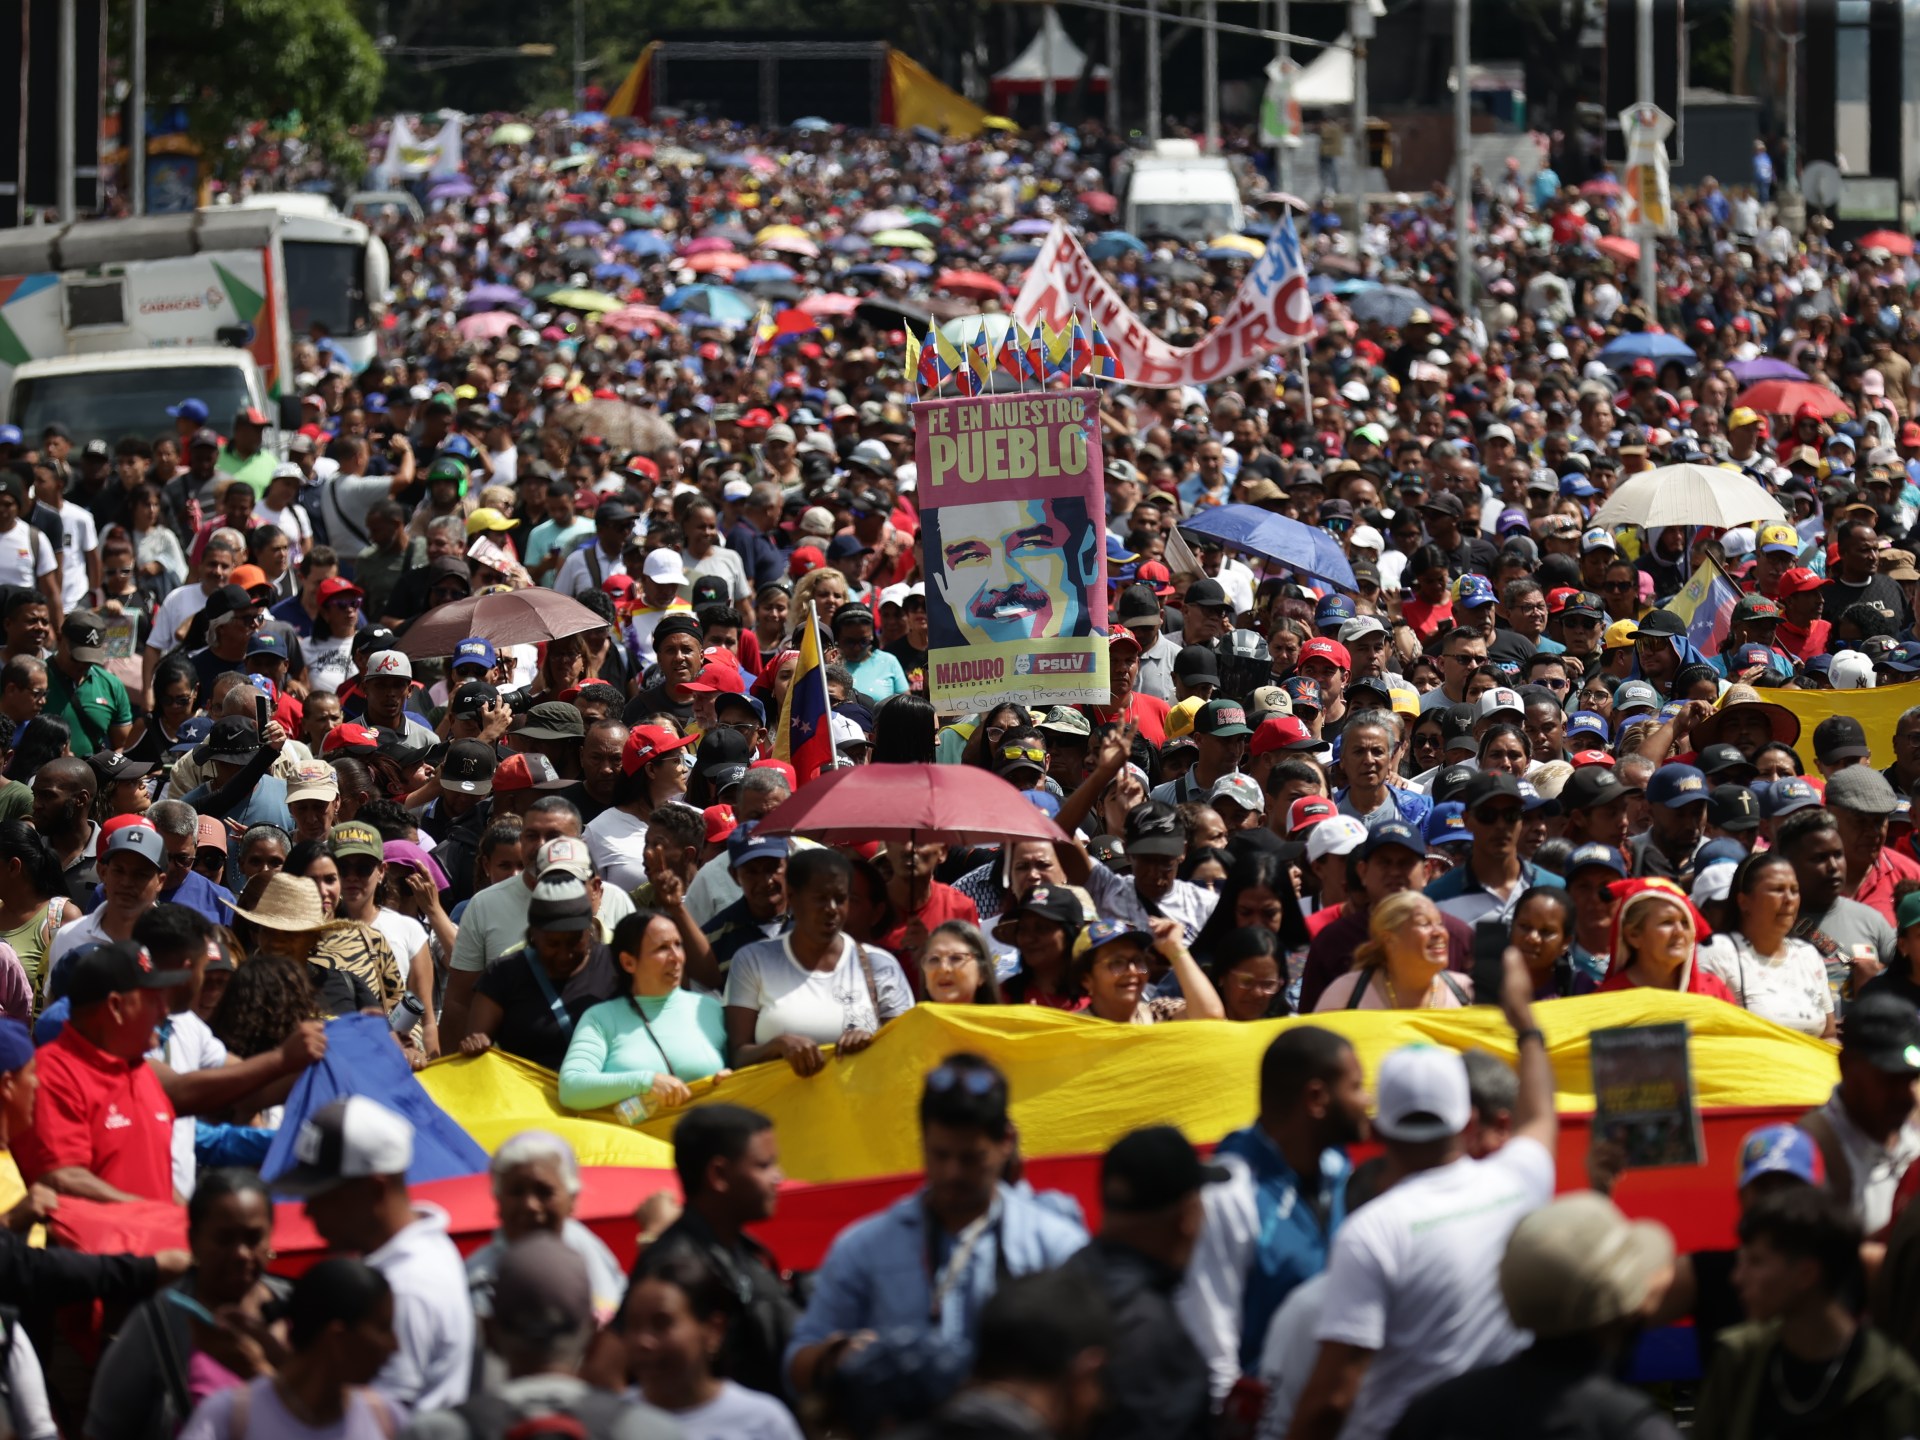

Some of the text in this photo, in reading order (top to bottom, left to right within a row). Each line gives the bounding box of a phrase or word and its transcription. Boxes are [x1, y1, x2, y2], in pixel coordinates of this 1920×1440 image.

[928, 397, 1085, 433] FE EN NUESTRO
[929, 423, 1088, 486] PUEBLO
[1322, 608, 1350, 617] MINEC
[936, 657, 1005, 685] MADURO
[1037, 654, 1085, 671] PSUV
[937, 678, 1004, 691] PRESIDENTE
